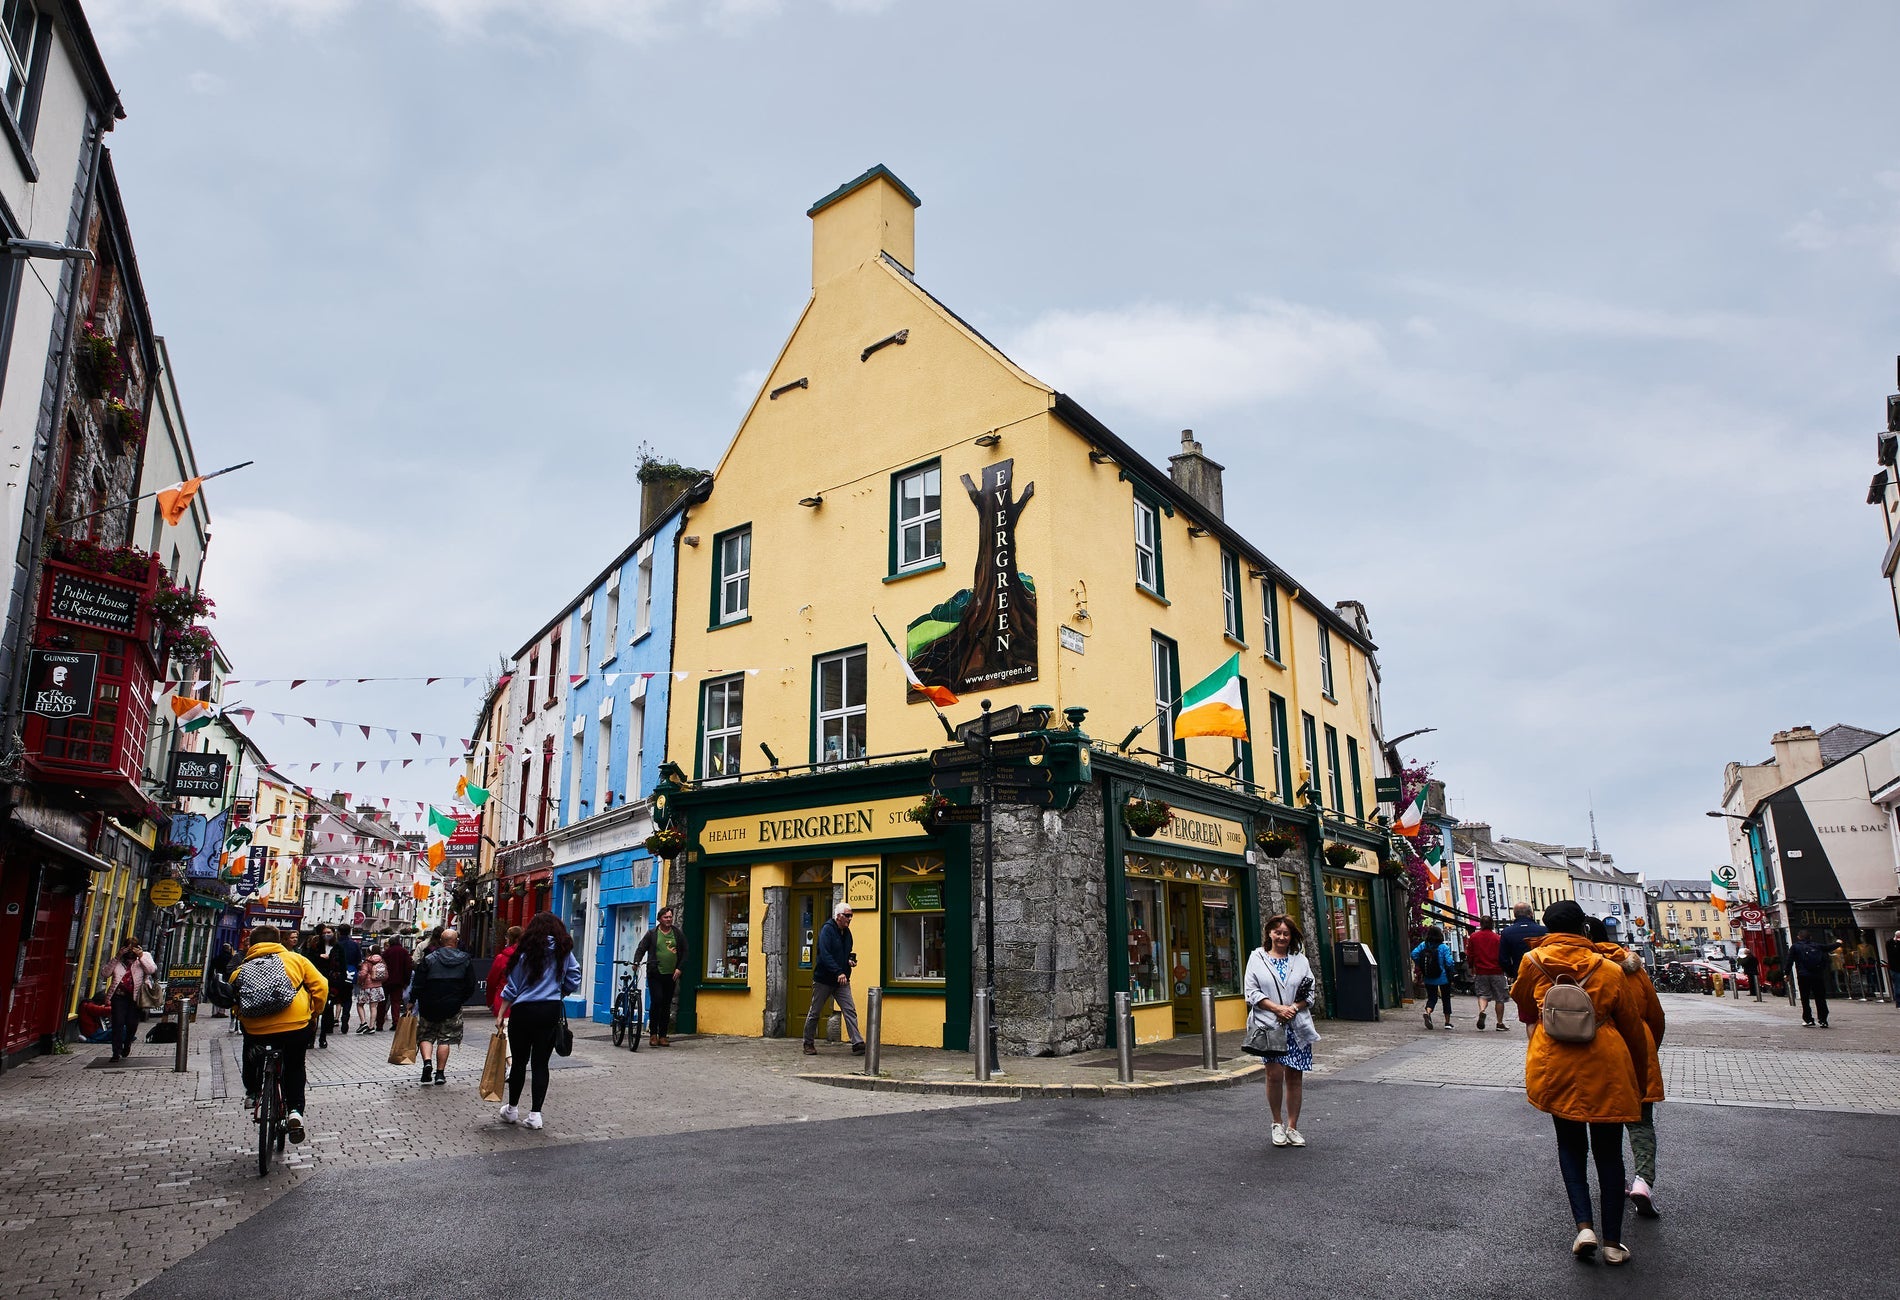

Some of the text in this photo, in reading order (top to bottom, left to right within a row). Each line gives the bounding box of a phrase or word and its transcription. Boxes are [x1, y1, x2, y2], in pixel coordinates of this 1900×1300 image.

[995, 470, 1010, 652] EVERGREEN
[62, 584, 129, 611] Public House
[58, 600, 129, 623] & Restaurant
[965, 664, 1032, 684] www.evergreen.ie
[35, 702, 73, 712] HEAD
[177, 769, 203, 777] HEAD
[176, 780, 219, 790] BISTRO
[709, 828, 747, 843] HEALTH
[758, 808, 874, 844] EVERGREEN
[1818, 825, 1847, 834] ELLIE
[1226, 831, 1242, 844] STORE
[850, 879, 875, 892] EVERGREEN
[850, 894, 874, 902] CORNER
